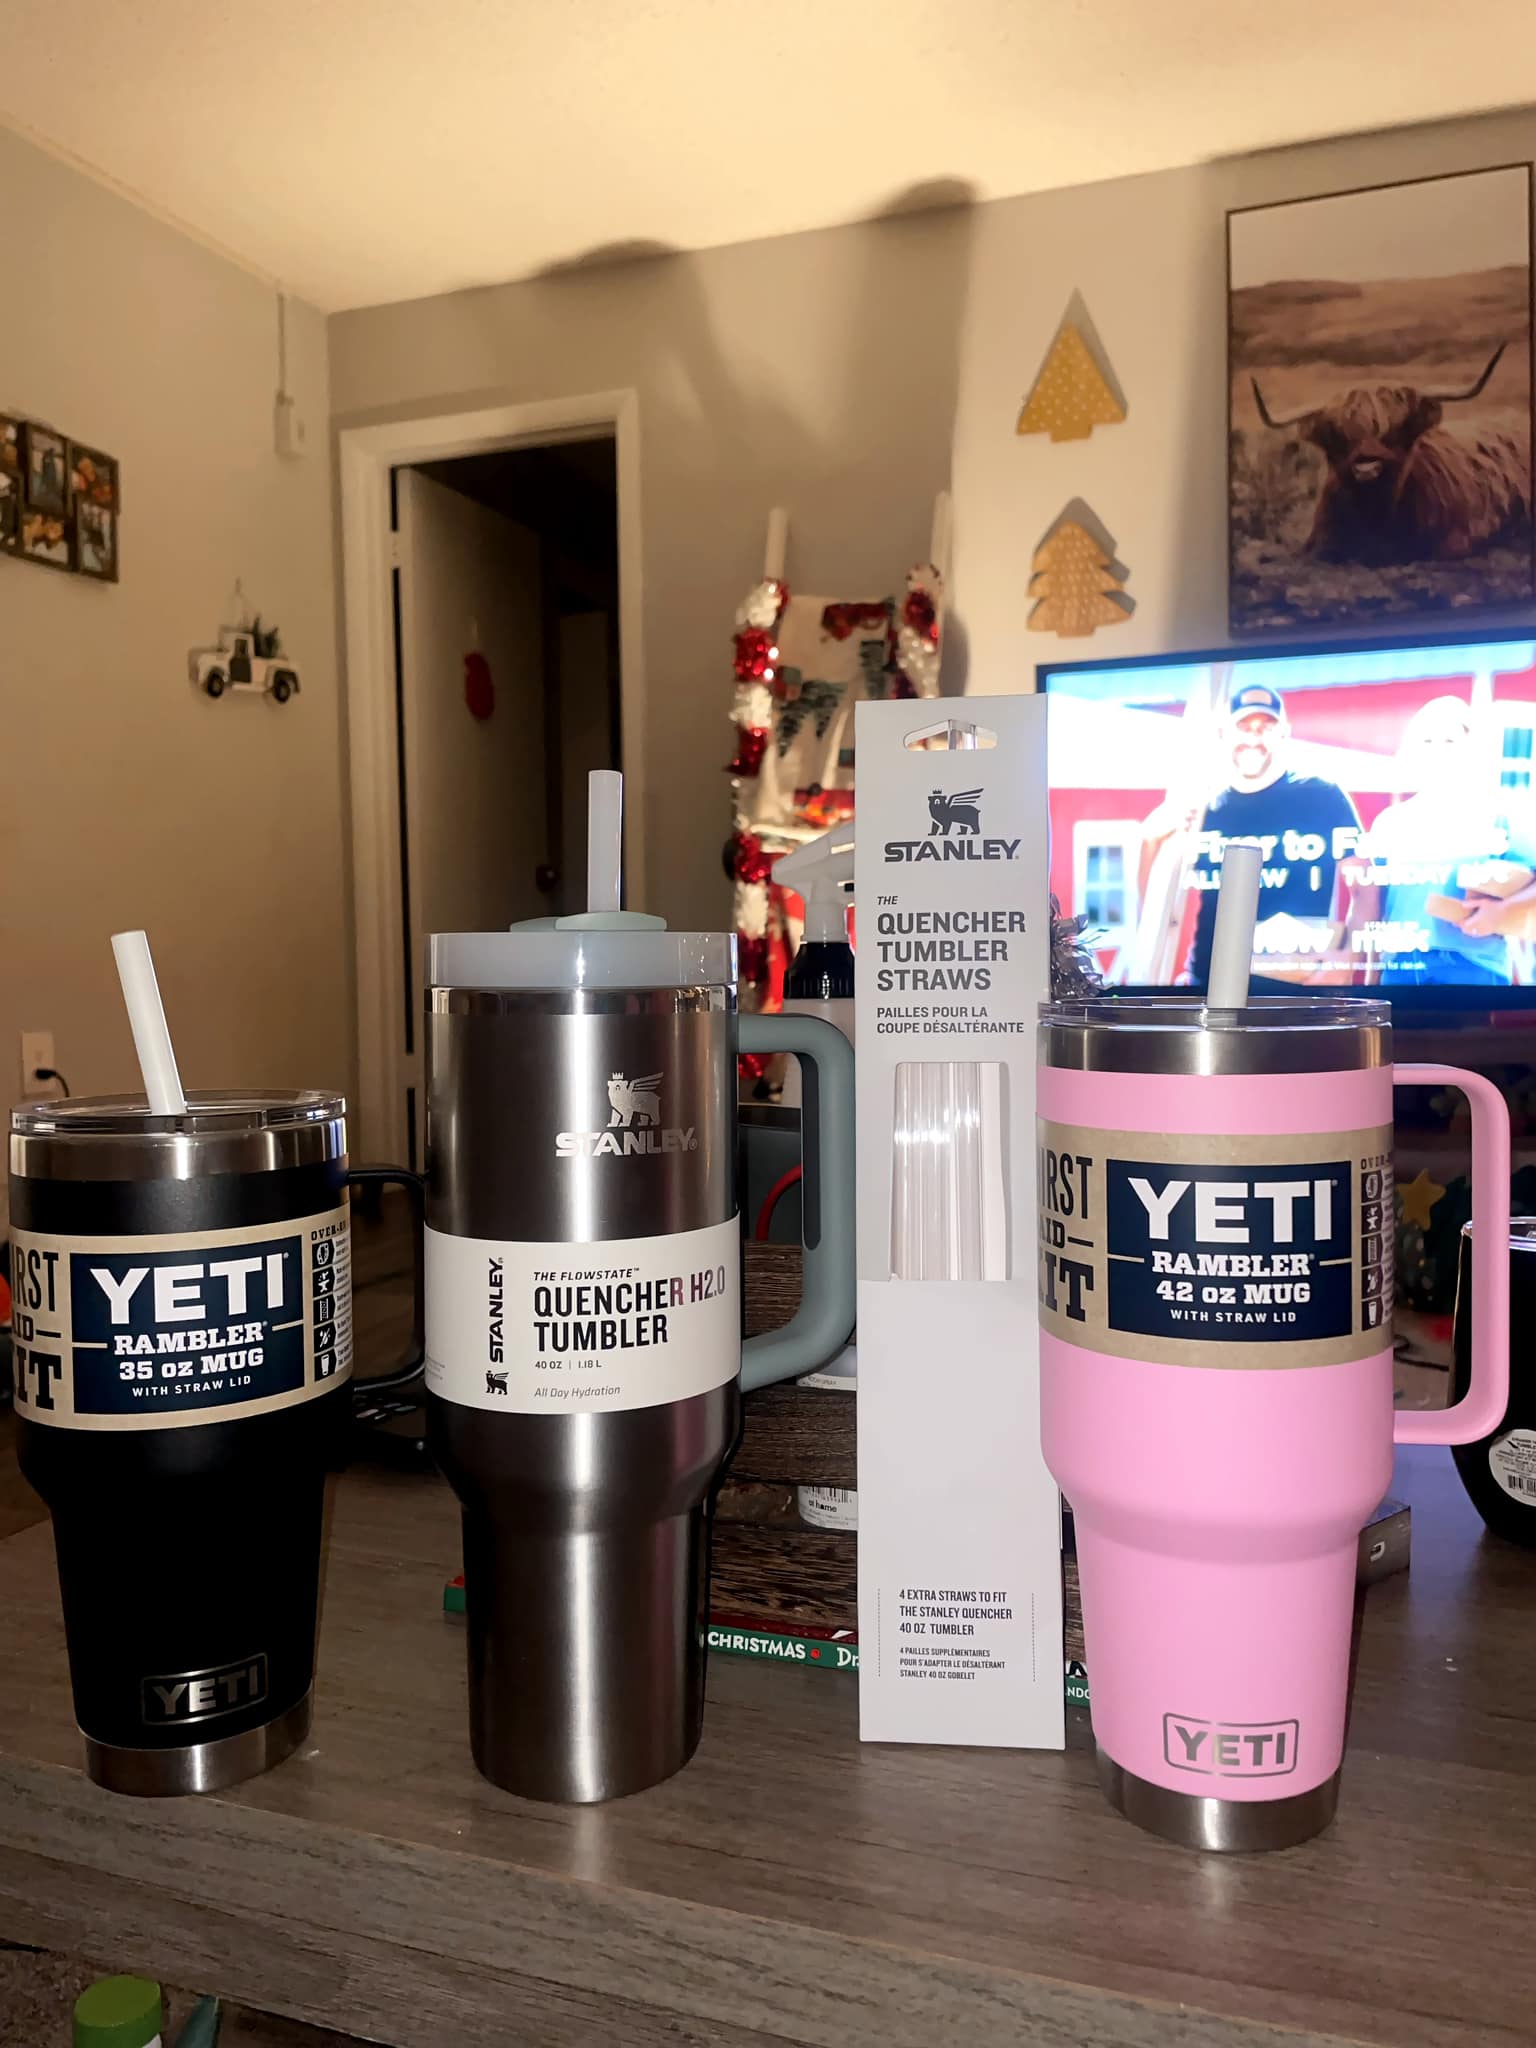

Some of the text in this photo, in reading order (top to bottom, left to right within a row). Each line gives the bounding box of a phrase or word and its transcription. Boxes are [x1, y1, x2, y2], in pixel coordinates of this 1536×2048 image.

[884, 839, 1022, 862] STANLEY
[1282, 829, 1325, 862] to
[877, 896, 898, 905] THE
[877, 911, 1026, 935] QUENCHER
[877, 940, 1008, 962] TUMBLER
[877, 968, 991, 991] STRAWS
[877, 1007, 988, 1018] PAILLES POUR LA
[877, 1020, 1024, 1033] COUPE DÉSALTÉRANTE
[1036, 1147, 1093, 1219] IRST
[12, 1246, 59, 1312] IRST
[533, 1271, 557, 1281] THE
[534, 1265, 726, 1318] QUENCHER H2.0
[1156, 1281, 1194, 1302] 42
[1243, 1284, 1311, 1304] MUG
[1170, 1309, 1297, 1323] WITH STRAW LID
[533, 1314, 668, 1352] TUMBLER
[119, 1361, 153, 1381] 35
[201, 1347, 264, 1374] MUG
[534, 1361, 548, 1370] 40
[549, 1360, 563, 1370] OZ
[596, 1359, 602, 1368] L
[132, 1376, 251, 1398] WITH STRAW LID
[534, 1385, 621, 1399] All Day Hydration
[899, 1589, 1007, 1603] 4 EXTRA STRAWS TO FIT
[900, 1605, 1012, 1620] THE STANLEY QUENCHER
[900, 1622, 974, 1635] 40 OZ TUMBLER
[707, 1631, 806, 1659] CHRISTMAS
[905, 1647, 930, 1655] PAILLES
[900, 1658, 917, 1667] POUR
[918, 1659, 952, 1668] S'ADAPTER
[953, 1660, 961, 1668] LE
[900, 1670, 927, 1679] STANLEY
[928, 1671, 937, 1679] 40
[947, 1671, 975, 1680] GOBELET
[152, 1665, 258, 1715] YETI
[1174, 1724, 1286, 1767] YETI
